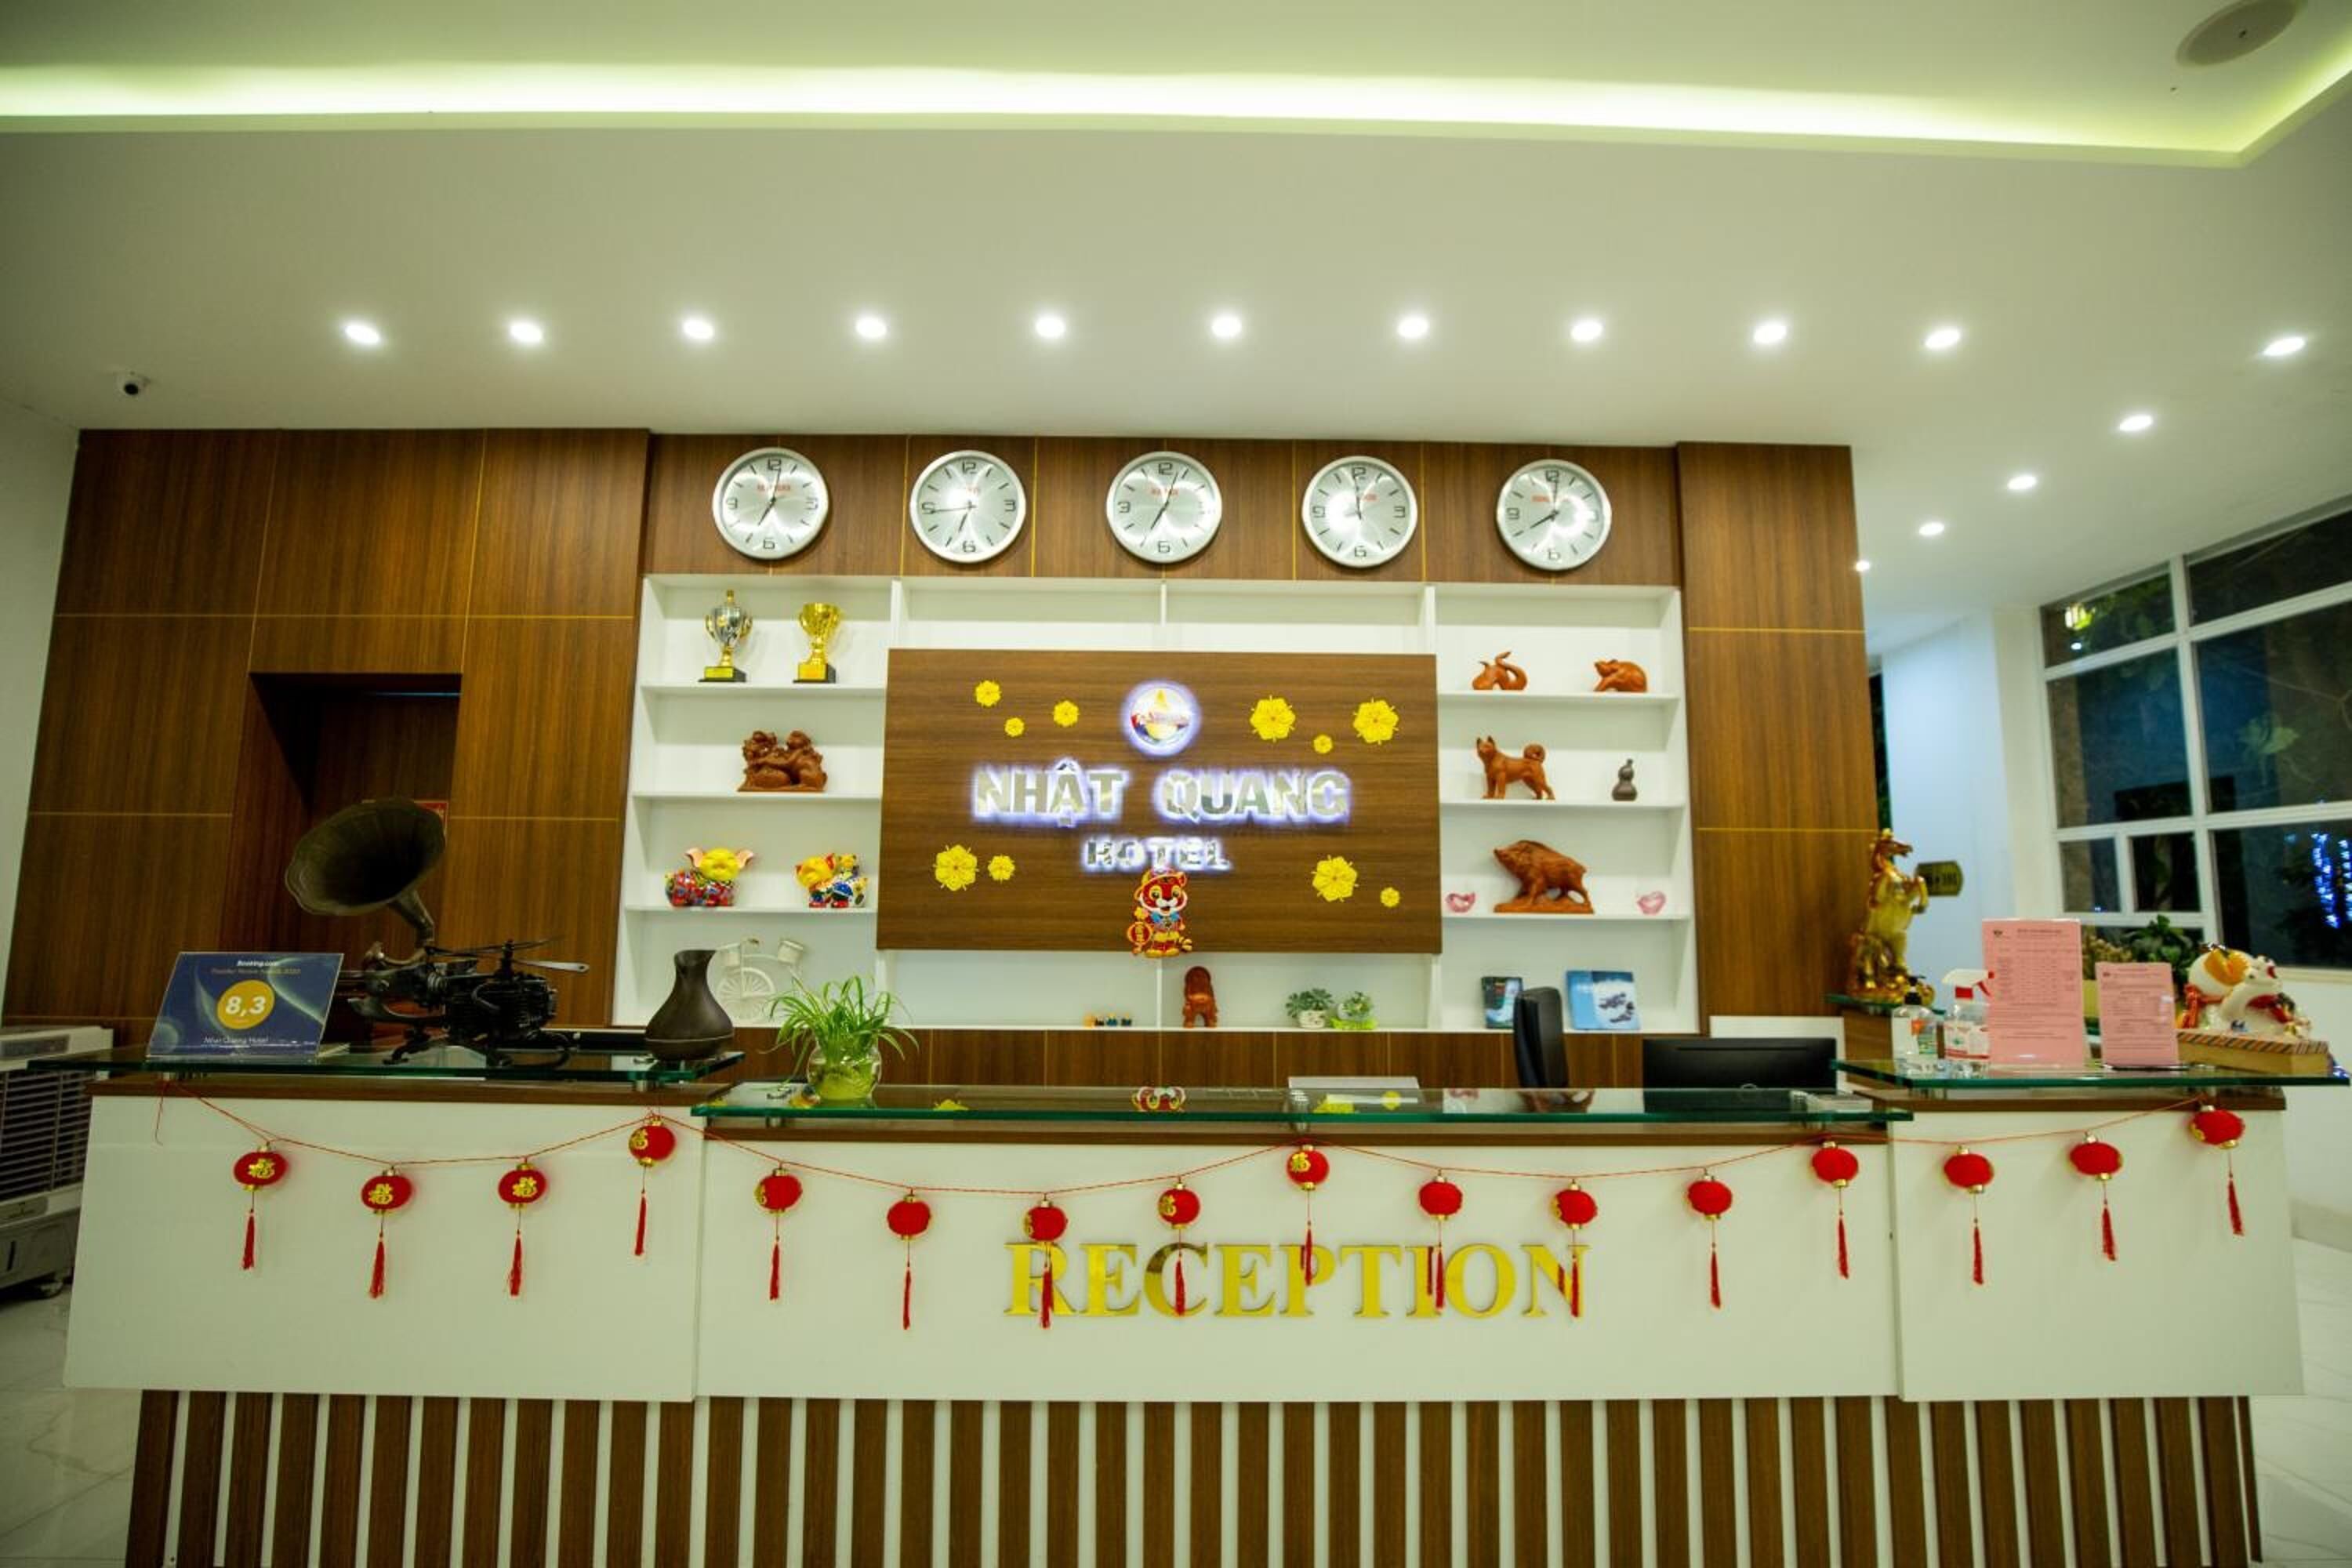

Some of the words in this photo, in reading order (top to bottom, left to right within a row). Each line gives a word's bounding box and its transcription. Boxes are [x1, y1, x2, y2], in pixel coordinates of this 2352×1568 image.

[767, 459, 782, 471] 12
[962, 461, 977, 474] 12
[1158, 462, 1173, 475] 12
[1352, 466, 1367, 480] 12
[1004, 499, 1017, 512] 3
[1312, 506, 1326, 517] 9
[1394, 506, 1406, 518] 3
[763, 537, 775, 550] 6
[962, 540, 976, 553] 6
[1157, 541, 1171, 553] 6
[1354, 546, 1367, 557] 6
[975, 759, 1127, 827] NHẬT
[1160, 771, 1350, 822] QUANG
[1087, 839, 1229, 869] HOTEL
[225, 996, 266, 1017] 8,3
[1004, 1242, 1590, 1318] RECEPTION
